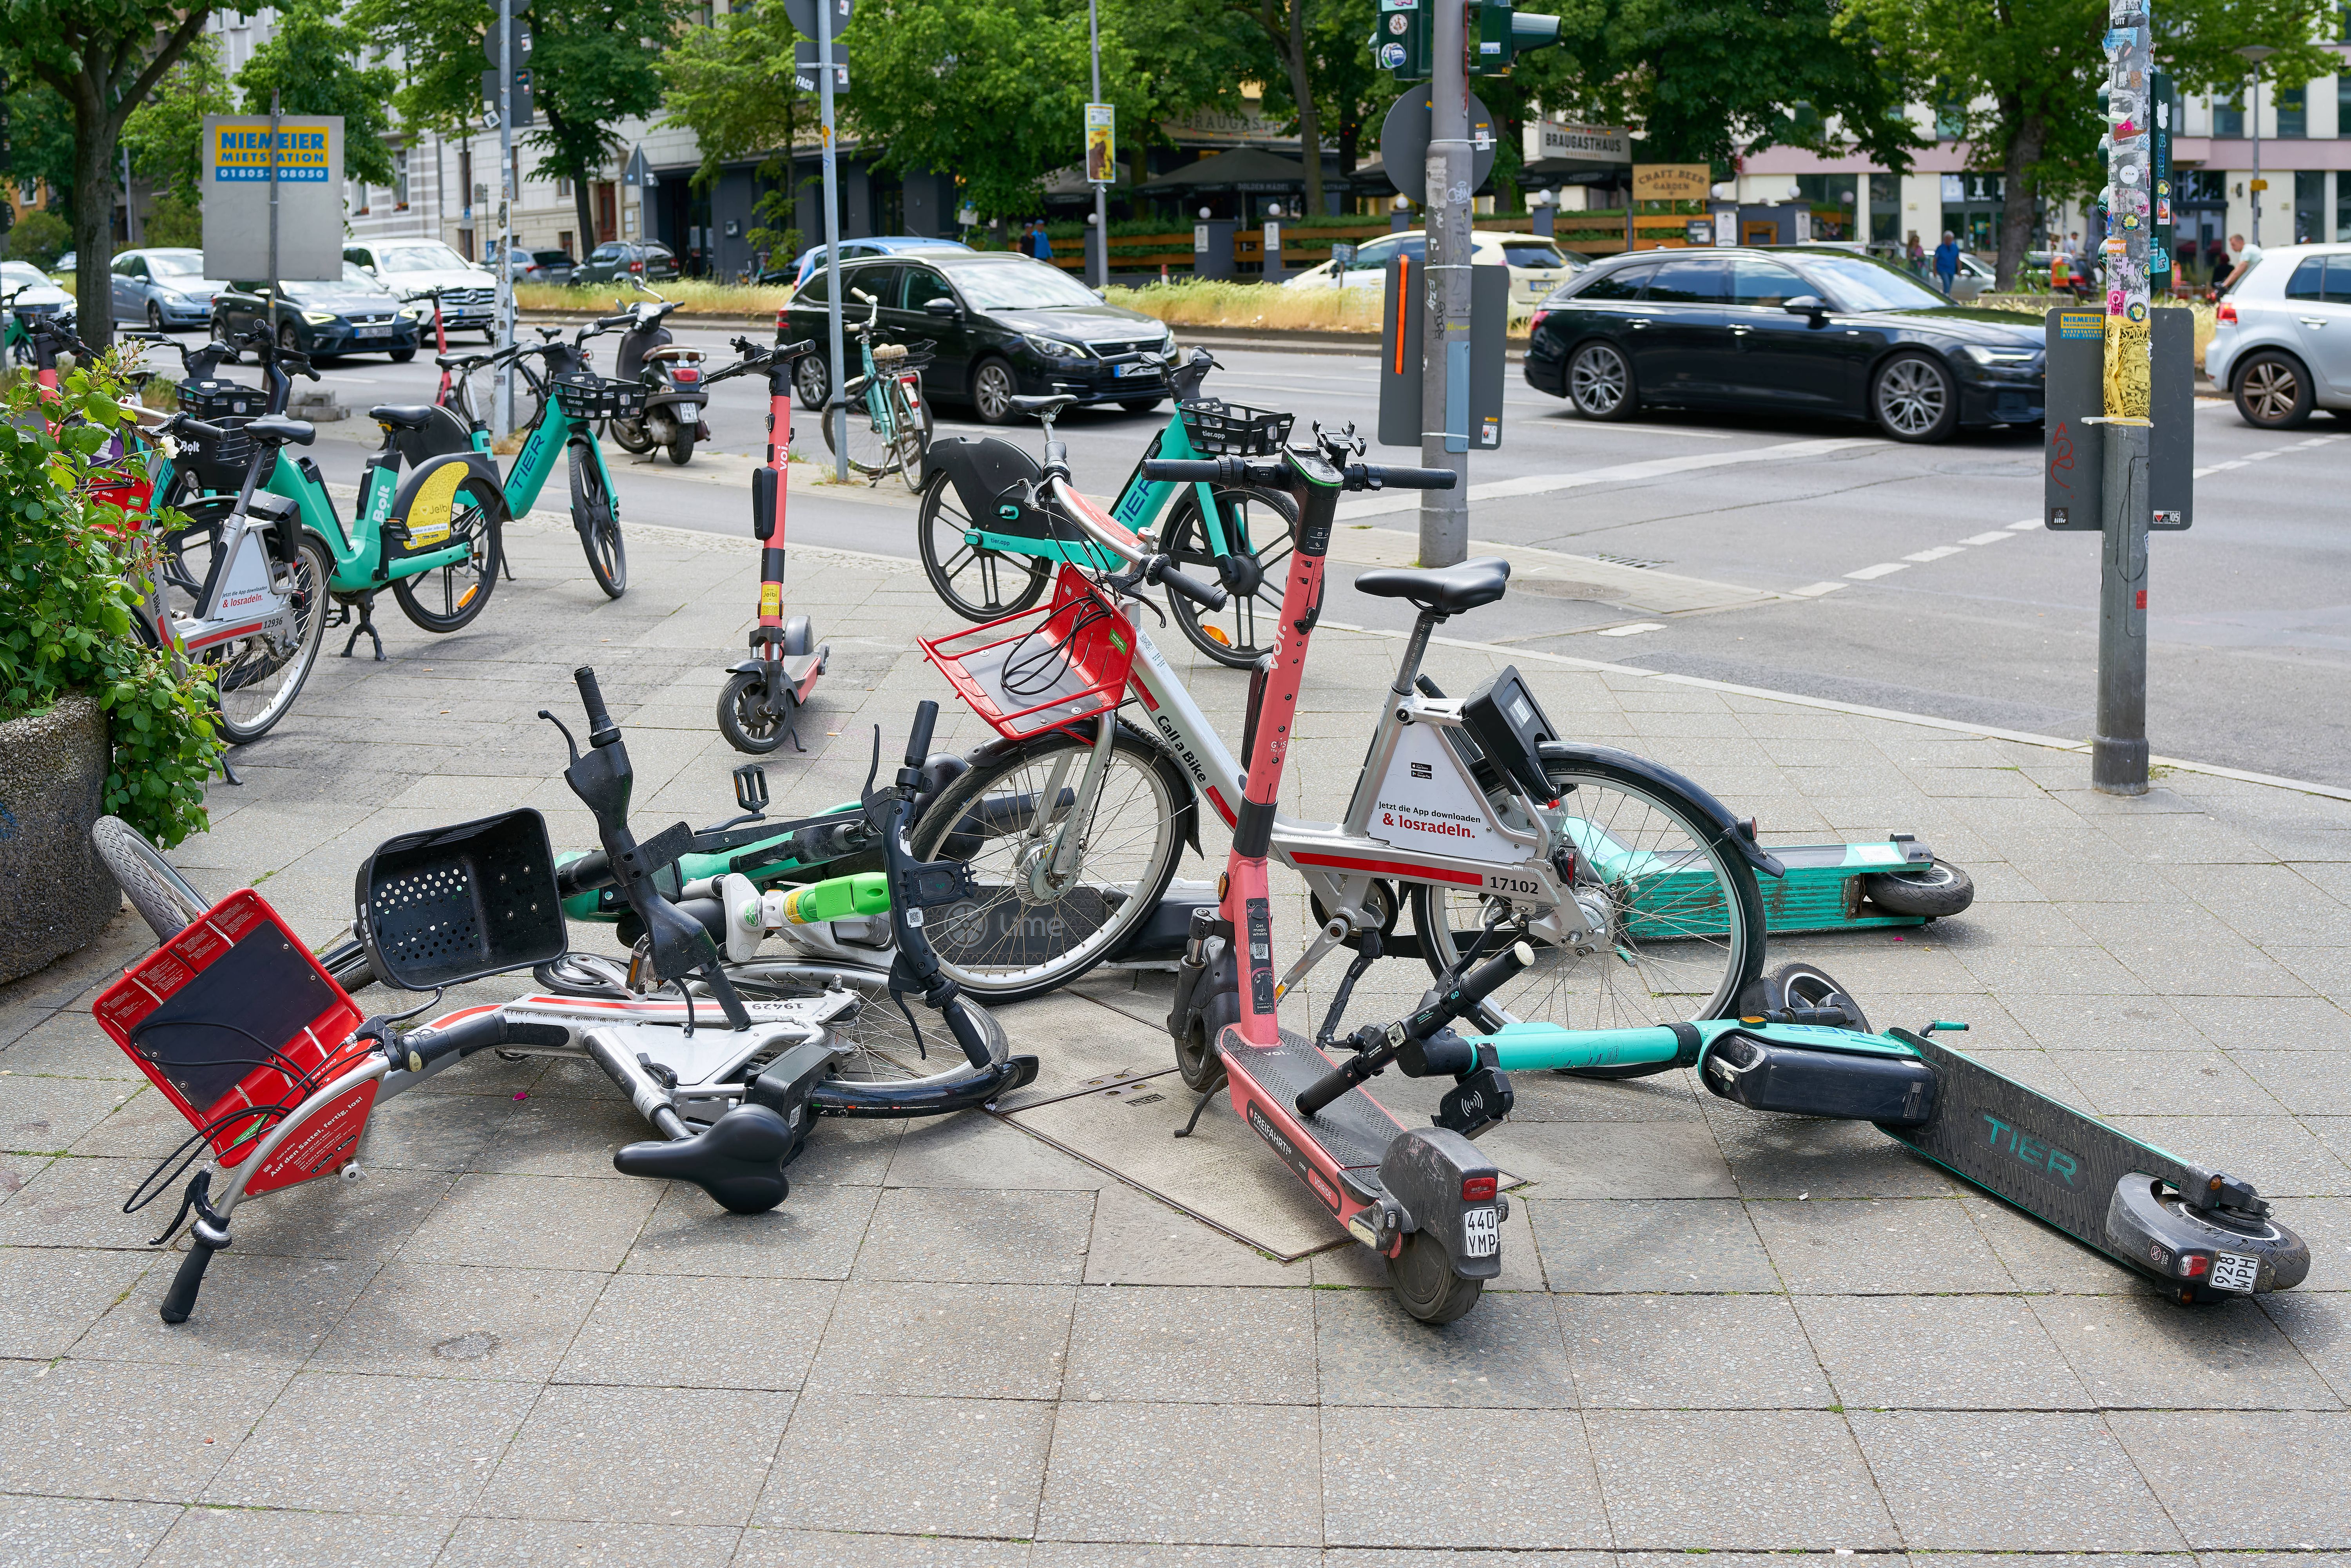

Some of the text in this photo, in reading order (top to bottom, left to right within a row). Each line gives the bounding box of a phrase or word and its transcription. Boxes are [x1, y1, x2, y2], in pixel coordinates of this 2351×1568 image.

[221, 133, 324, 149] NIEMEIER
[1546, 133, 1621, 152] BRAUGASTHAUS
[221, 169, 324, 178] 01805-08050
[1638, 170, 1705, 185] CRAFT BEER
[1202, 430, 1225, 439] tier.app
[182, 441, 199, 455] Bolt
[777, 442, 788, 471] voi.
[511, 434, 545, 489] TIER
[372, 485, 390, 523] Bolt
[430, 503, 450, 514] Jelbi
[1117, 480, 1156, 522] IER
[991, 538, 1010, 546] tier.app
[223, 595, 263, 608] & losradeln.
[263, 617, 283, 629] 12936
[1270, 625, 1287, 669] voi.
[1157, 715, 1206, 782] Call a Bike
[1378, 801, 1481, 824] Jetzt die App downloaden
[1382, 813, 1476, 839] & losradeln.
[1490, 876, 1539, 895] 17102
[360, 902, 373, 947] Bolt
[1351, 961, 1361, 974] URSUS
[1451, 991, 1459, 999] GO
[1786, 1025, 1877, 1041] TIER
[324, 1058, 338, 1069] Call
[310, 1071, 322, 1080] Bik
[269, 1095, 363, 1177] Auf den Sattel, fertig, los!
[301, 1152, 310, 1161] laden,
[309, 1141, 322, 1153] QR-Code
[321, 1131, 334, 1143] scannen,
[334, 1120, 347, 1132] losradeln
[322, 1137, 335, 1149] member
[276, 1152, 285, 1160] Call
[286, 1142, 296, 1151] Bike
[301, 1158, 315, 1171] Download
[348, 1124, 356, 1132] going
[1984, 1115, 2077, 1186] TIER
[317, 1159, 328, 1168] Google
[1314, 1176, 1332, 1200] VOIRIDE
[1468, 1211, 1494, 1231] 440
[1468, 1234, 1496, 1254] YMP
[2214, 1257, 2236, 1284] 928
[2234, 1260, 2255, 1290] WPH
